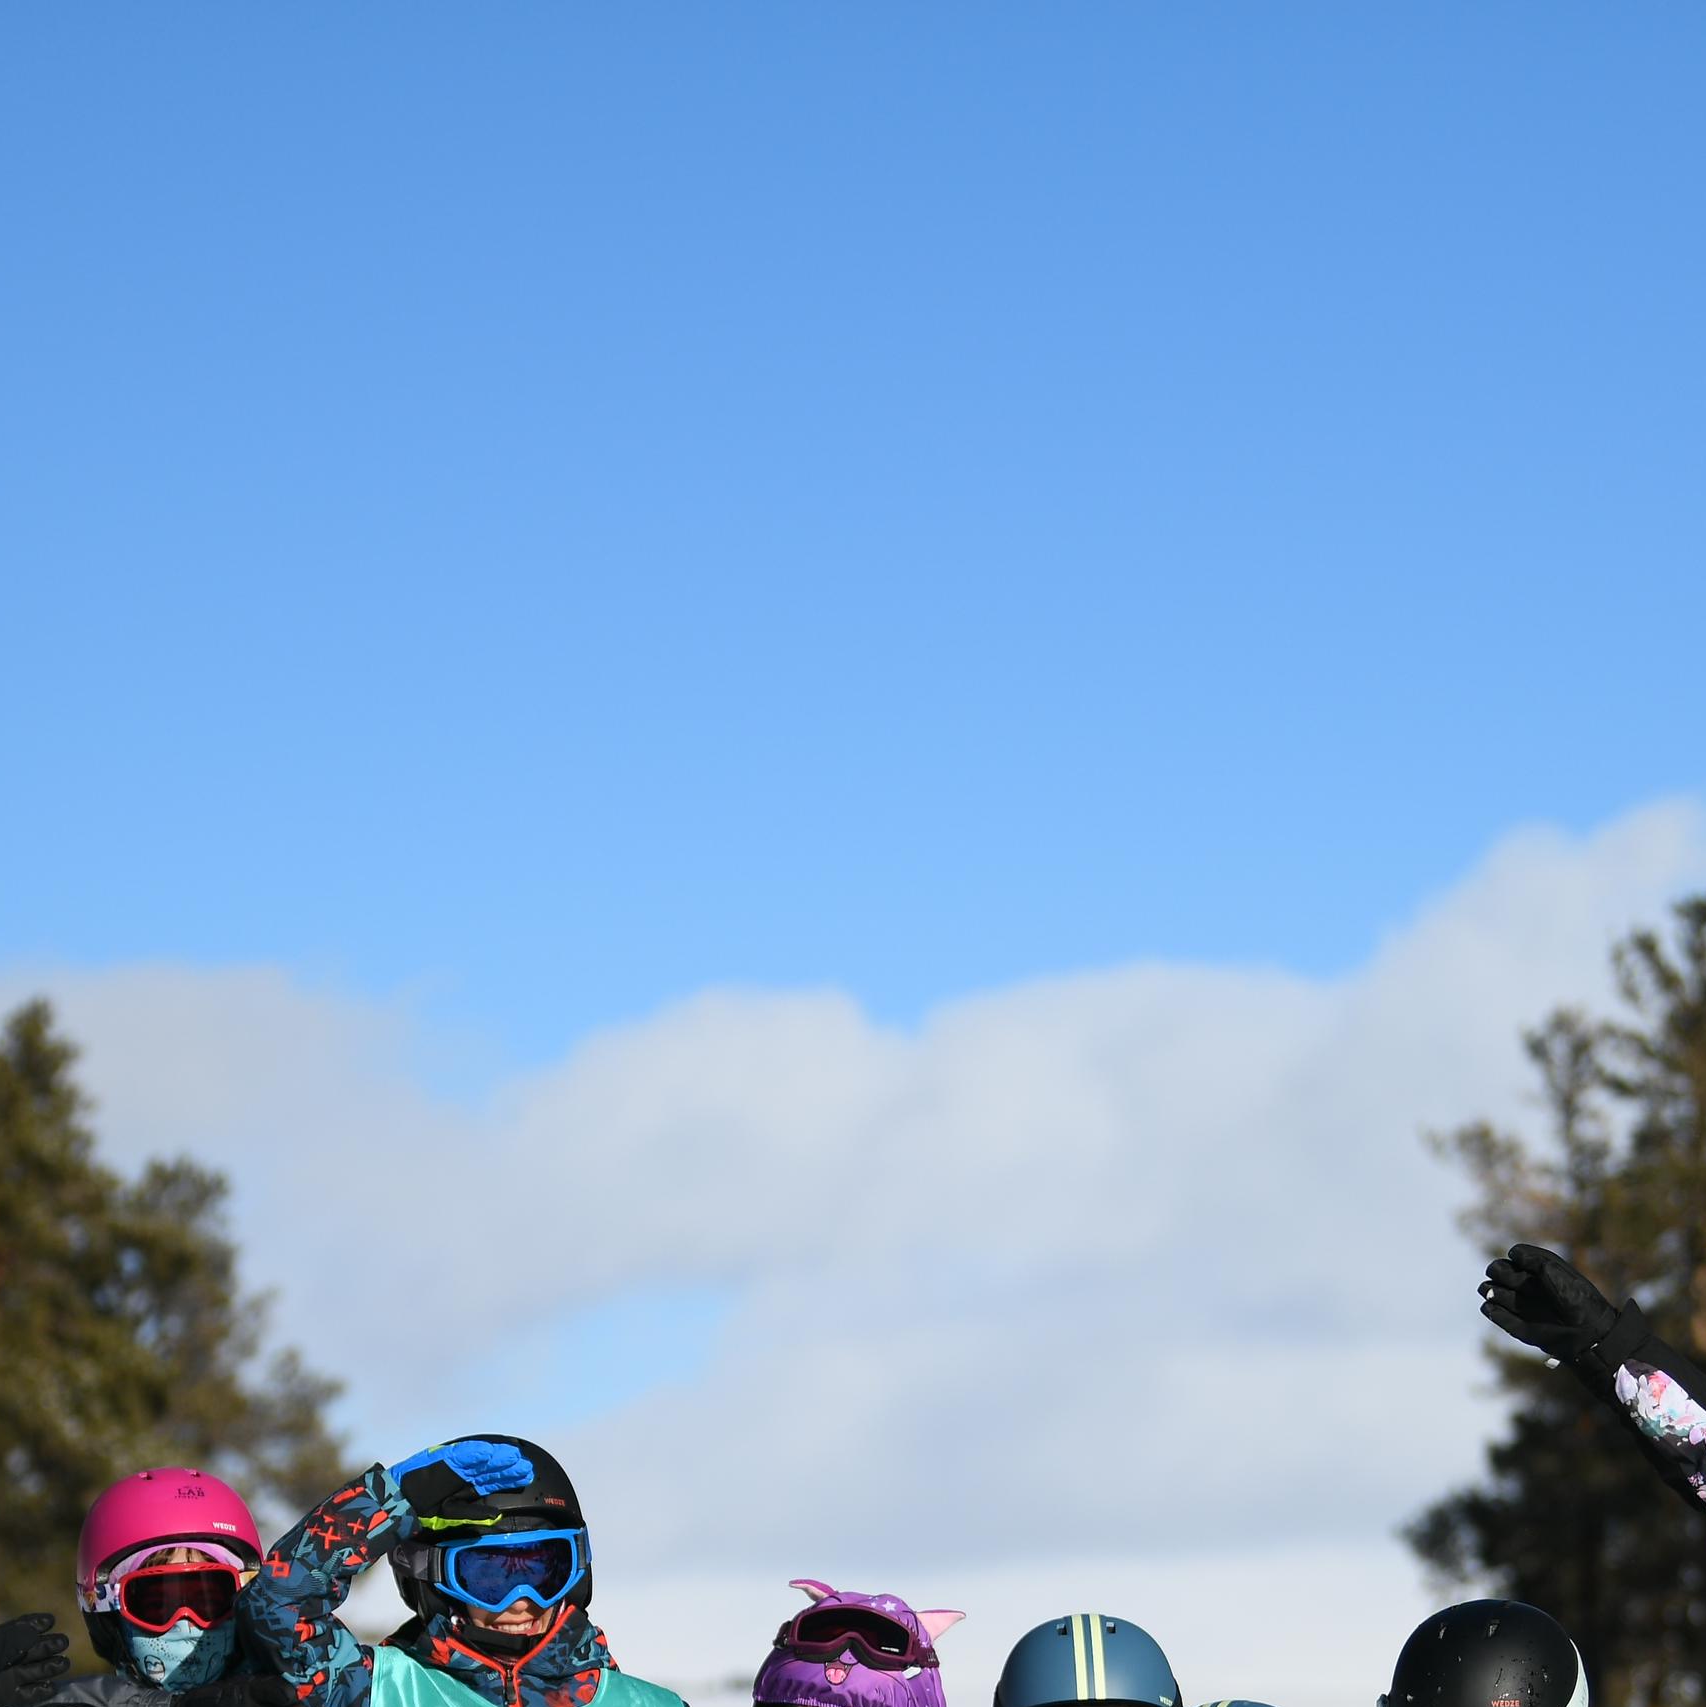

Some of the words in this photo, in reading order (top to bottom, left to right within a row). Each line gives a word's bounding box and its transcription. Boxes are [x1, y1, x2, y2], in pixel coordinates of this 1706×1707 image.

[544, 1497, 566, 1507] WEDZE
[212, 1522, 237, 1532] WEDZE
[1491, 1700, 1521, 1707] WEDZE
